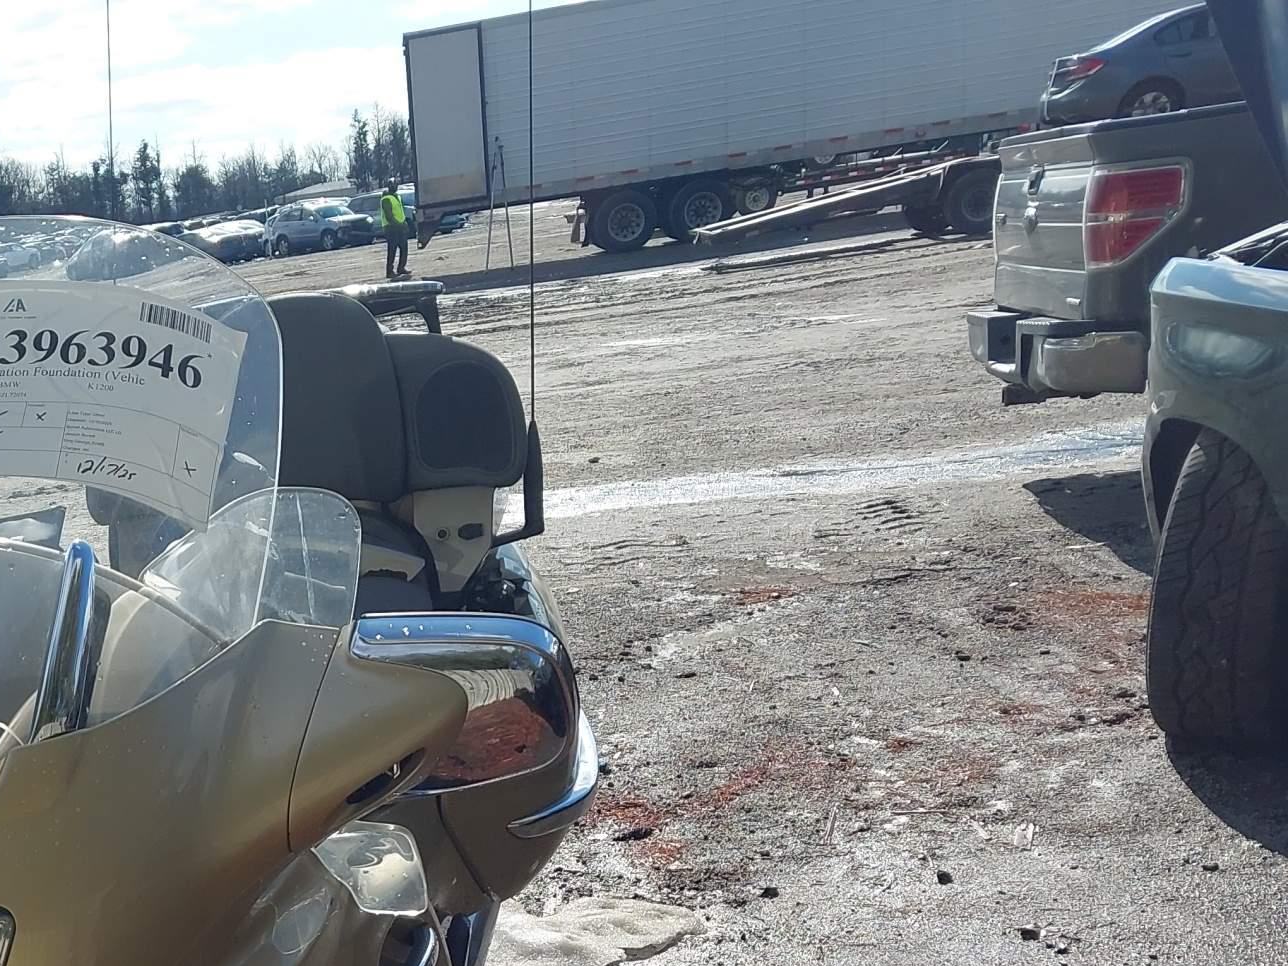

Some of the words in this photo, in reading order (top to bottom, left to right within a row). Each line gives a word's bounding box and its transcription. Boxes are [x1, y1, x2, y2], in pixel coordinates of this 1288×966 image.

[33, 366, 101, 380] Foundation
[105, 370, 145, 386] (Vehic
[87, 382, 114, 392] K1200
[77, 456, 137, 480] 12/17/25
